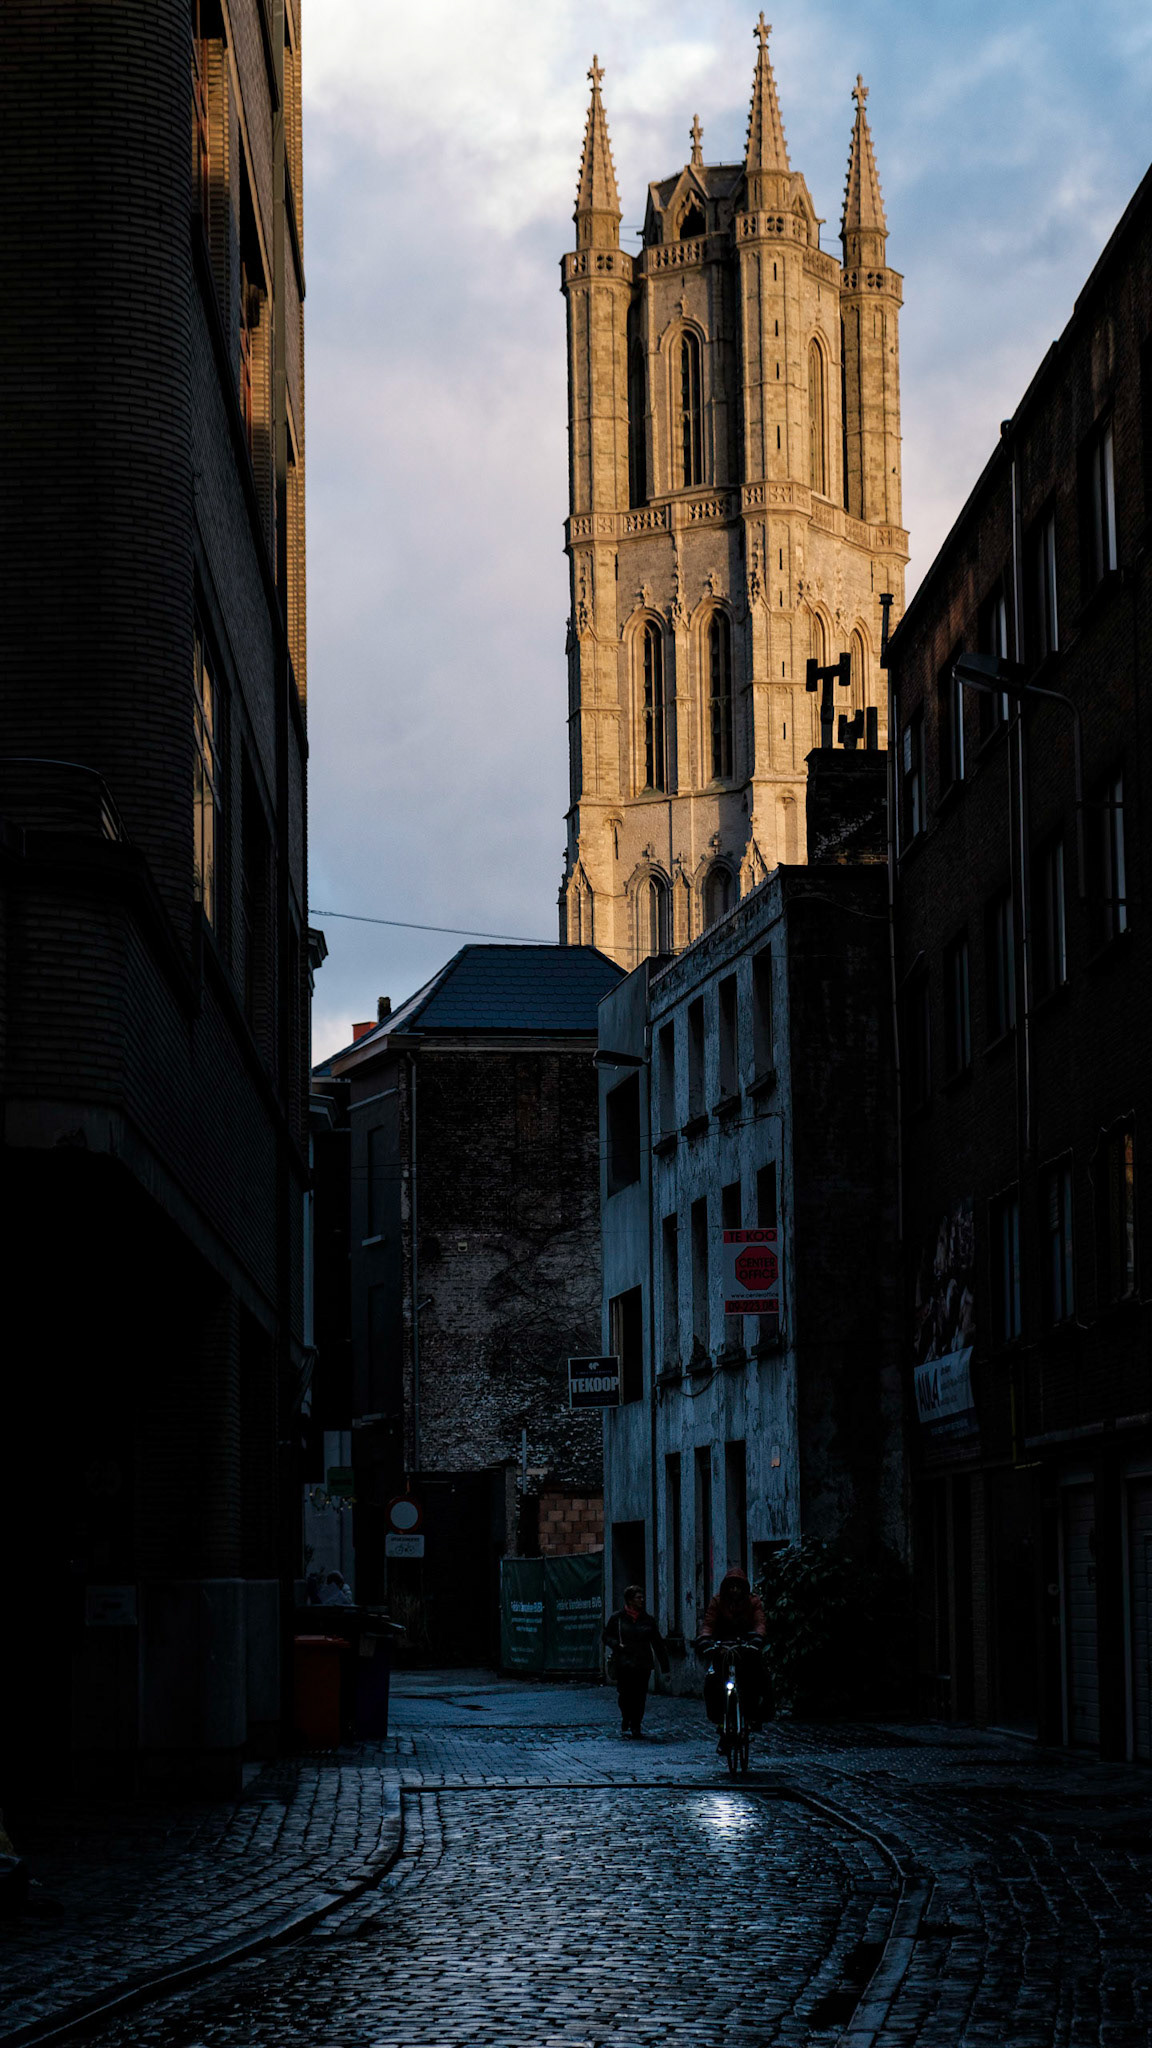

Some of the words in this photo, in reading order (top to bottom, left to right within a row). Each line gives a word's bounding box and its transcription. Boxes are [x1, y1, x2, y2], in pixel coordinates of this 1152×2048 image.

[729, 1231, 742, 1243] TE
[746, 1230, 777, 1242] KOO
[738, 1257, 775, 1268] CENTER
[739, 1269, 776, 1280] OFFICE
[731, 1291, 778, 1299] www.centeroffice
